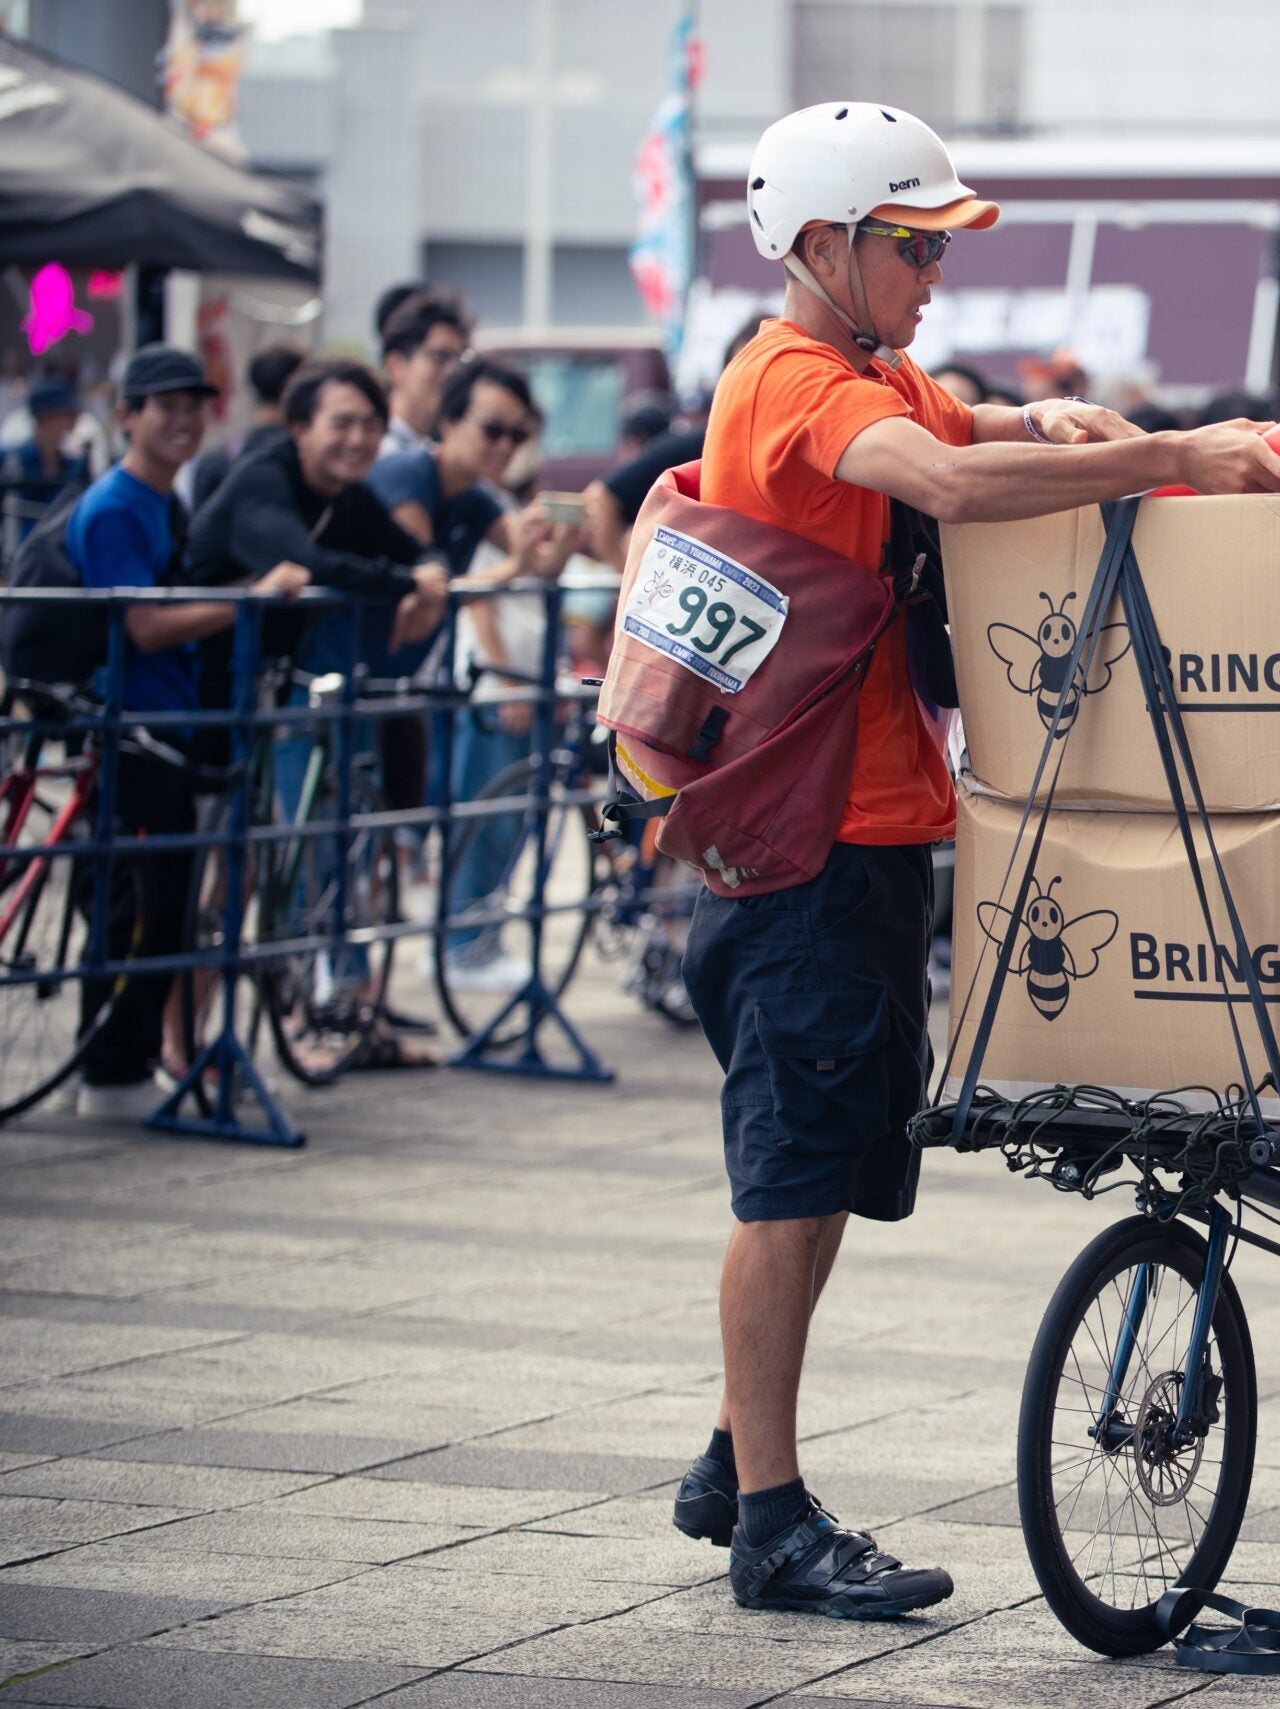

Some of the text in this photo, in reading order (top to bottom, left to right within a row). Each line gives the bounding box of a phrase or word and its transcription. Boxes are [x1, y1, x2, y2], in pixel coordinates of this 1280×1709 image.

[889, 177, 920, 193] bern
[669, 554, 727, 592] 横浜 045
[742, 576, 761, 593] 2023
[666, 586, 767, 666] 997
